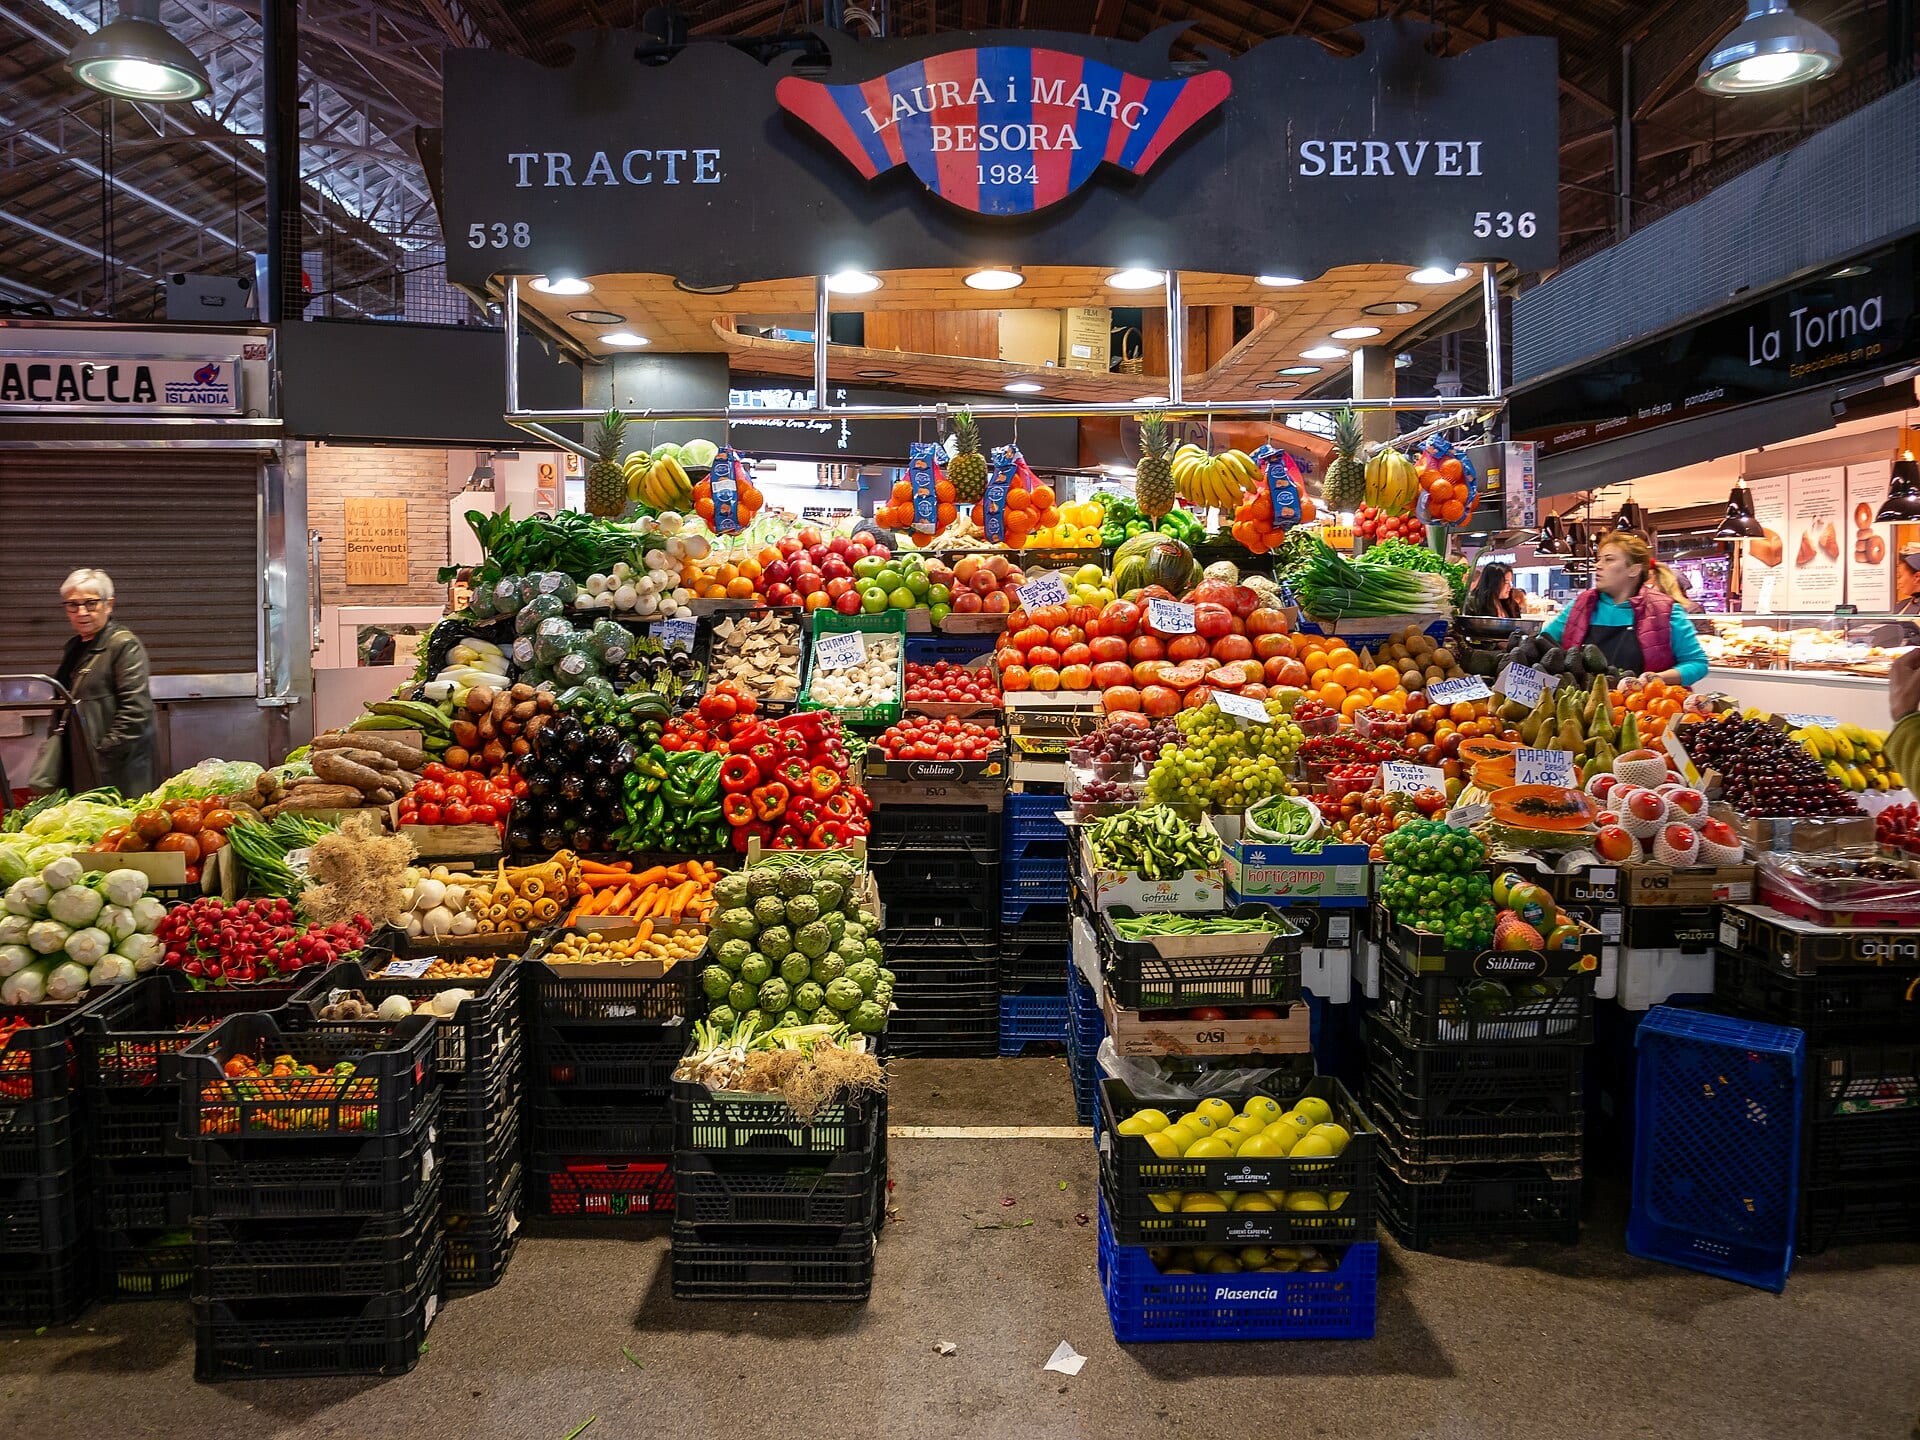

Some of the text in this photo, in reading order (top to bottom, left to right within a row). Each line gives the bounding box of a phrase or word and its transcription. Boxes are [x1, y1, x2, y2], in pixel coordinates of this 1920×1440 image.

[862, 76, 1150, 134] LAURA i MARC
[930, 123, 1082, 152] BESORA
[1300, 140, 1483, 177] SERVEI
[508, 149, 722, 188] TRACTE
[976, 164, 1039, 185] 1984
[1473, 212, 1537, 238] 536
[468, 222, 531, 248] 538
[1748, 295, 1882, 367] La Torna
[165, 393, 229, 404] ISLANDIA
[1652, 404, 1661, 416] de
[540, 464, 553, 480] Q
[347, 506, 405, 520] WELCOME
[347, 528, 406, 537] WILLKOMEN
[347, 543, 407, 553] Benvenuti
[818, 634, 856, 651] CHAMPI
[1510, 662, 1537, 680] PERA
[1429, 676, 1478, 696] NARANJA
[1518, 749, 1565, 764] PAPAYA
[917, 764, 955, 775] Sublime
[1384, 761, 1423, 773] Tomate
[1522, 770, 1561, 786] 4.99
[1247, 869, 1325, 884] horticampo
[1641, 877, 1669, 889] CASI
[1141, 892, 1180, 903] Gofruit
[1575, 887, 1617, 899] bubó
[1861, 943, 1918, 959] bubó
[1486, 957, 1536, 970] Sublime
[1196, 1032, 1225, 1043] CASI
[1215, 1287, 1278, 1301] Plasencia
